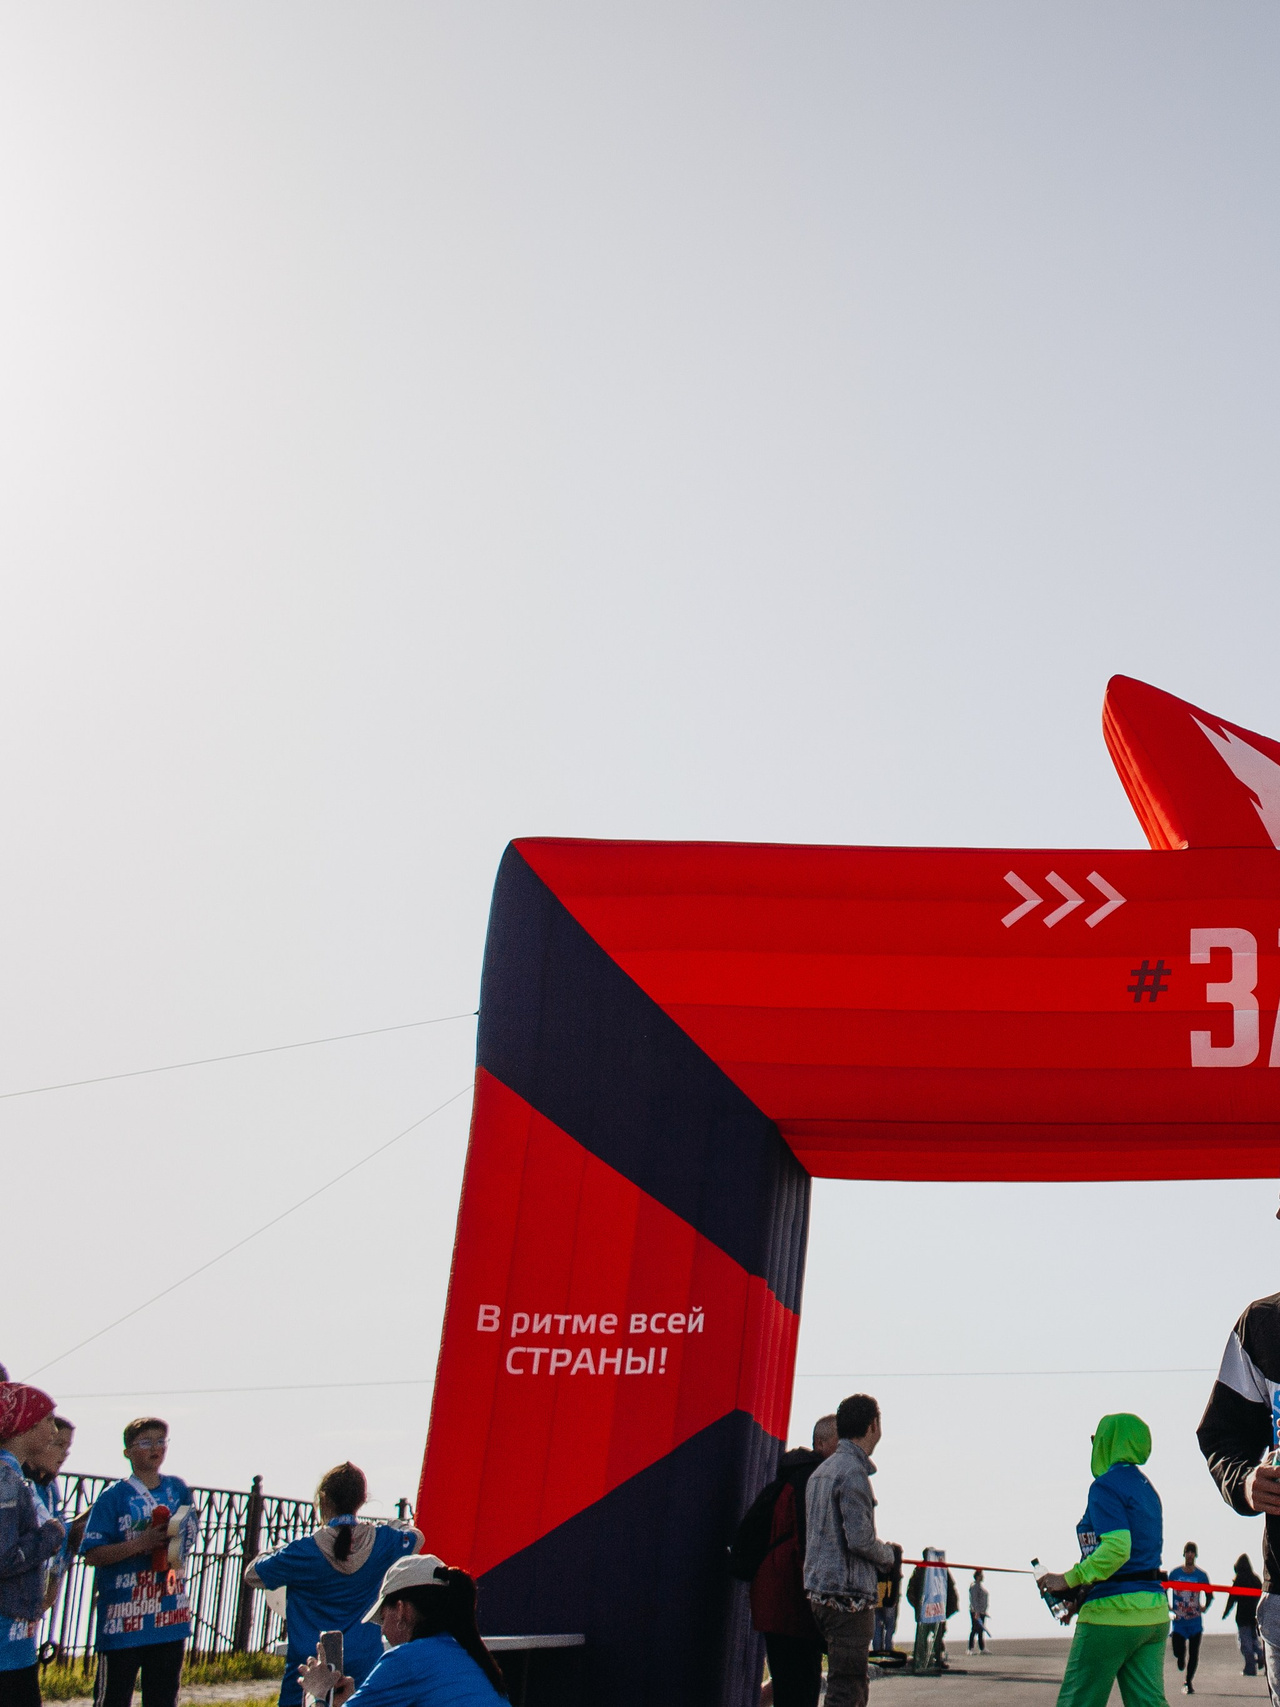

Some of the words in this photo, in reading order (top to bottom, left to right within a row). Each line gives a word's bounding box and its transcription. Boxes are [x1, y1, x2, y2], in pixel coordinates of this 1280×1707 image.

[476, 1303, 501, 1332] В
[510, 1311, 618, 1338] ритме
[629, 1305, 704, 1334] всей
[505, 1346, 668, 1375] СТРАНЫ!
